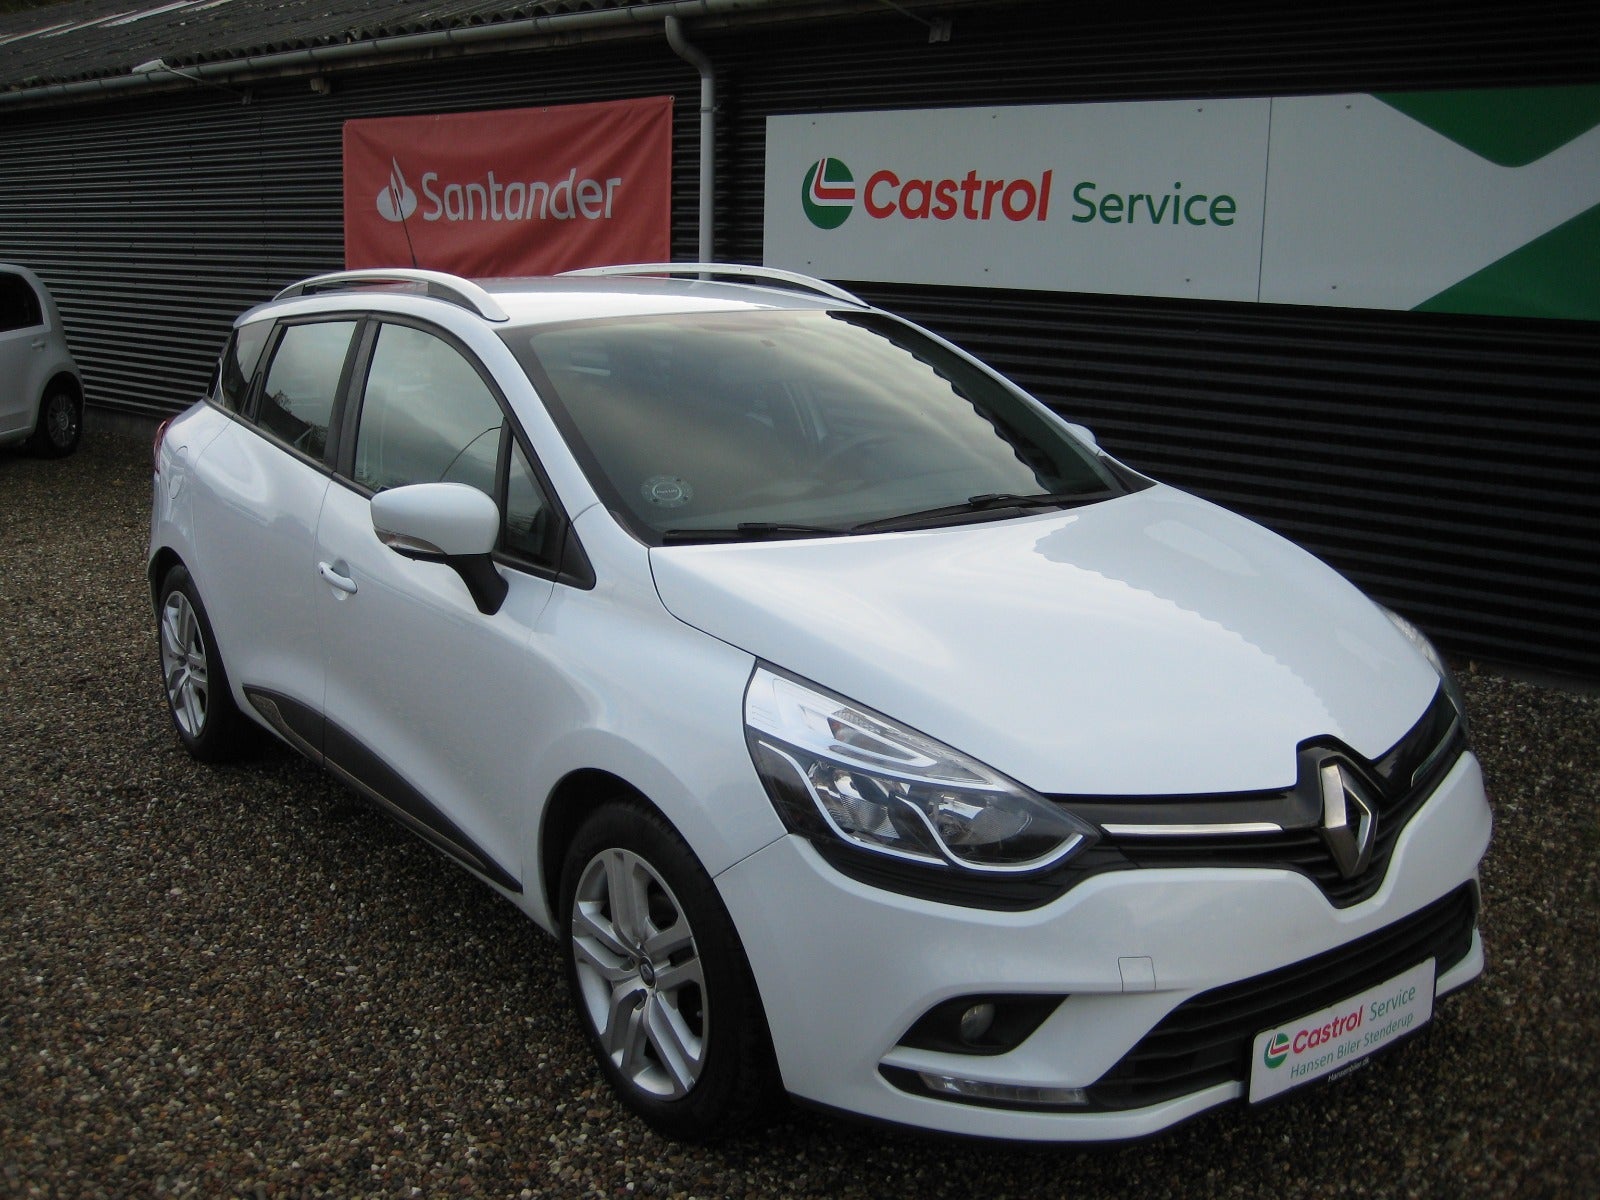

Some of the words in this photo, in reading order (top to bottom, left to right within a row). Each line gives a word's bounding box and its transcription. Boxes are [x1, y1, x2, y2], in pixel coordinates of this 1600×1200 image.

[422, 168, 622, 221] Santander
[864, 169, 1053, 221] Castrol
[1072, 181, 1236, 226] Service
[1290, 1053, 1333, 1079] Hansen
[1337, 1039, 1360, 1060] Biler
[1364, 1012, 1413, 1048] Stenderup
[1293, 1005, 1363, 1054] Castrol
[1369, 986, 1416, 1021] Service
